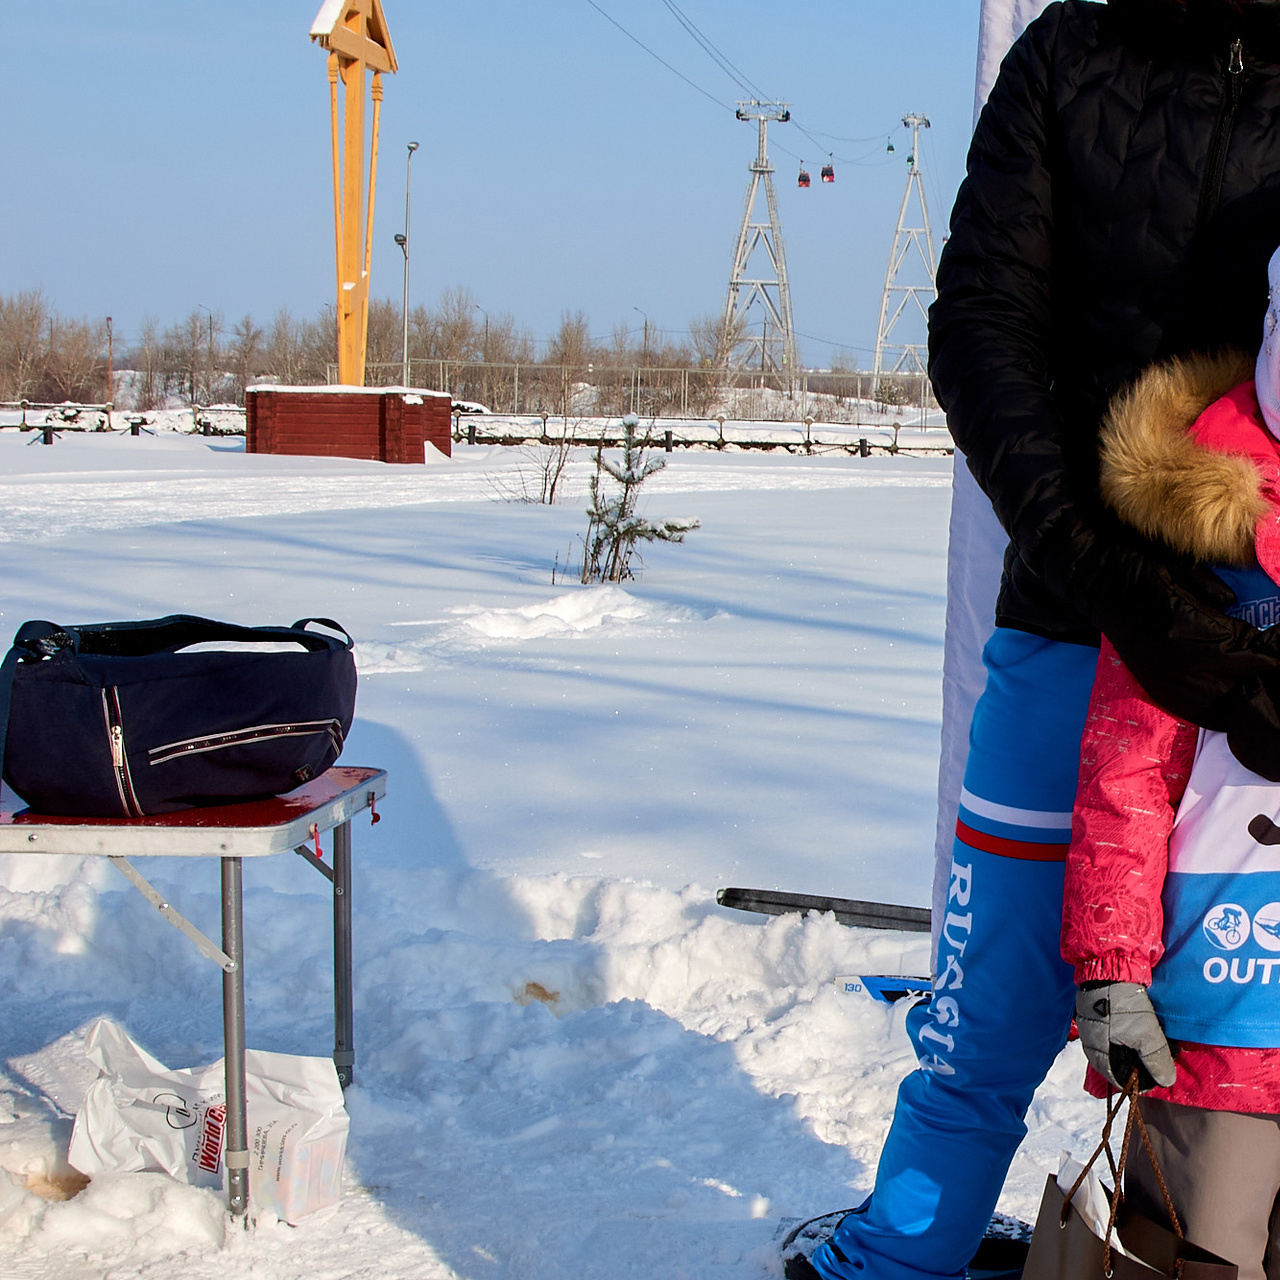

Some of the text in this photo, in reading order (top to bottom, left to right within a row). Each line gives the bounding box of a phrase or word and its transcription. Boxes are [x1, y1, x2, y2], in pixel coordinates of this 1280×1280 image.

[844, 982, 862, 993] 130
[919, 855, 973, 1076] RUSSIA
[200, 1120, 222, 1170] World
